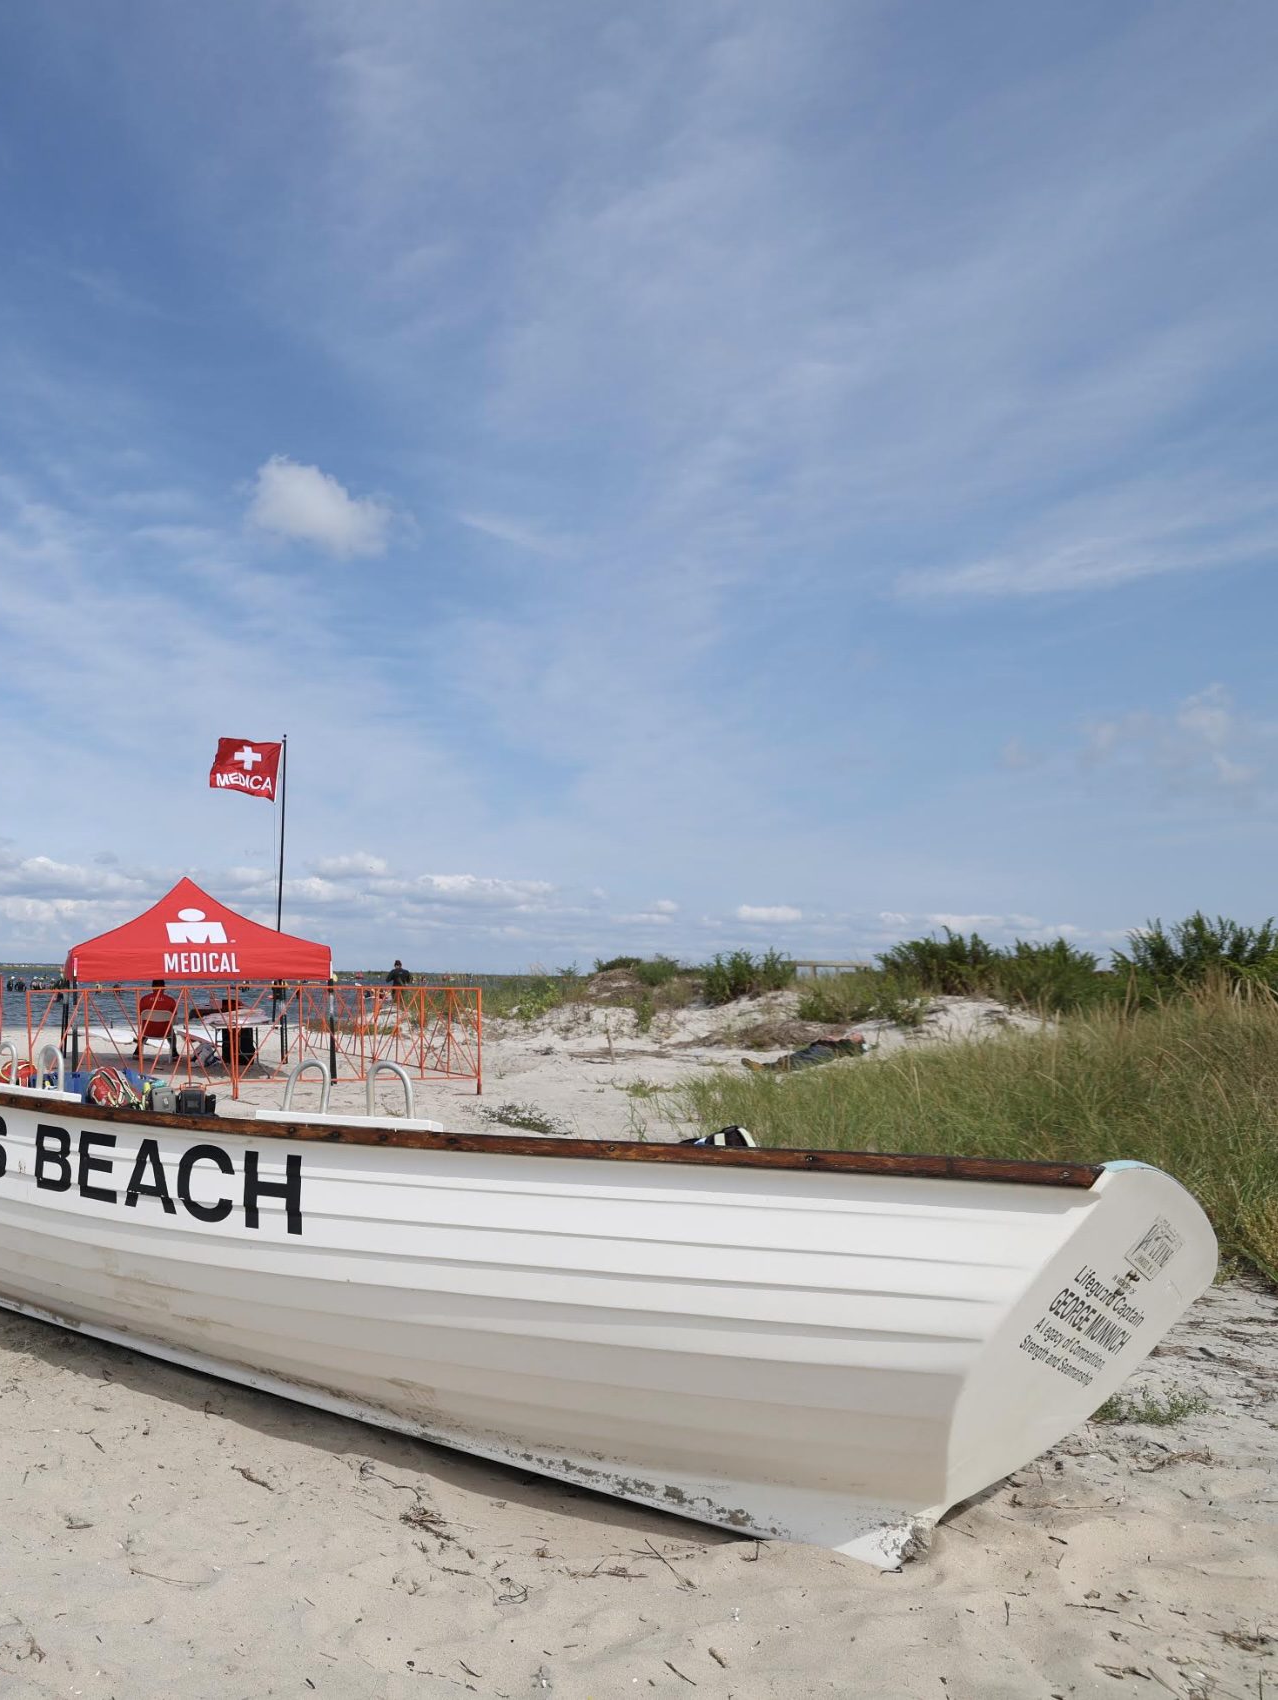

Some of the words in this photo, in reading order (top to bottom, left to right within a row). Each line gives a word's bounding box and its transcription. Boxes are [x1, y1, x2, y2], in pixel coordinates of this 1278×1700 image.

[164, 952, 241, 973] MEDICAL
[34, 1124, 303, 1236] BEACH
[1049, 1288, 1097, 1331] GEORGE
[1083, 1313, 1132, 1355] MUNNICH
[1112, 1296, 1144, 1328] Captain
[1034, 1317, 1045, 1331] A
[1062, 1338, 1076, 1349] of
[1019, 1334, 1050, 1361] Strength
[1045, 1354, 1063, 1368] and
